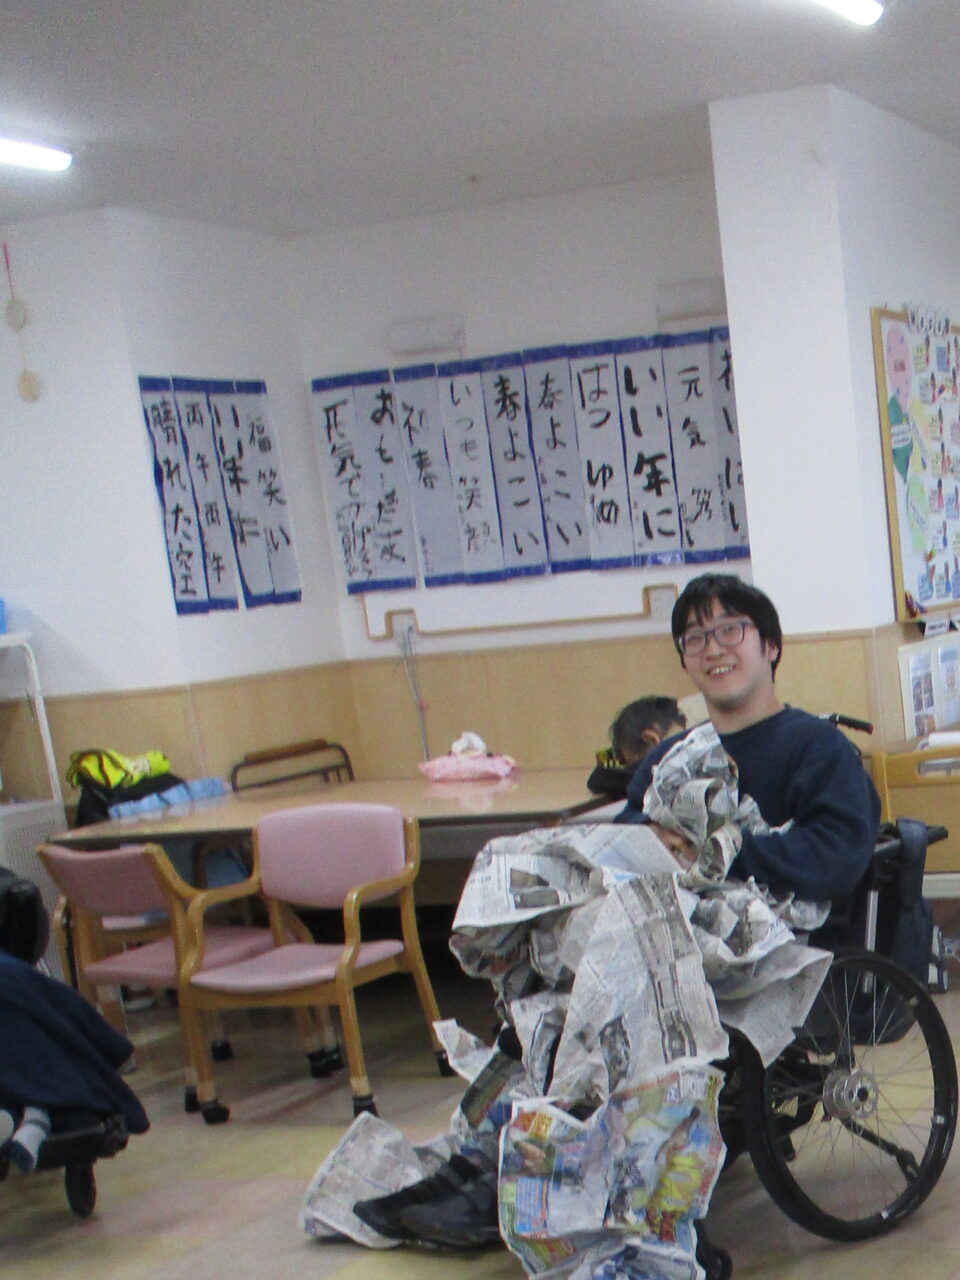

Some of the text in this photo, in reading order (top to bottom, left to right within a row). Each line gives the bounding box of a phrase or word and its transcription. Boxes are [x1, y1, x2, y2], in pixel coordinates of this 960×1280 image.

[493, 374, 540, 556] 春よこい
[538, 372, 583, 545] 春よこい
[623, 364, 676, 540] いい年に
